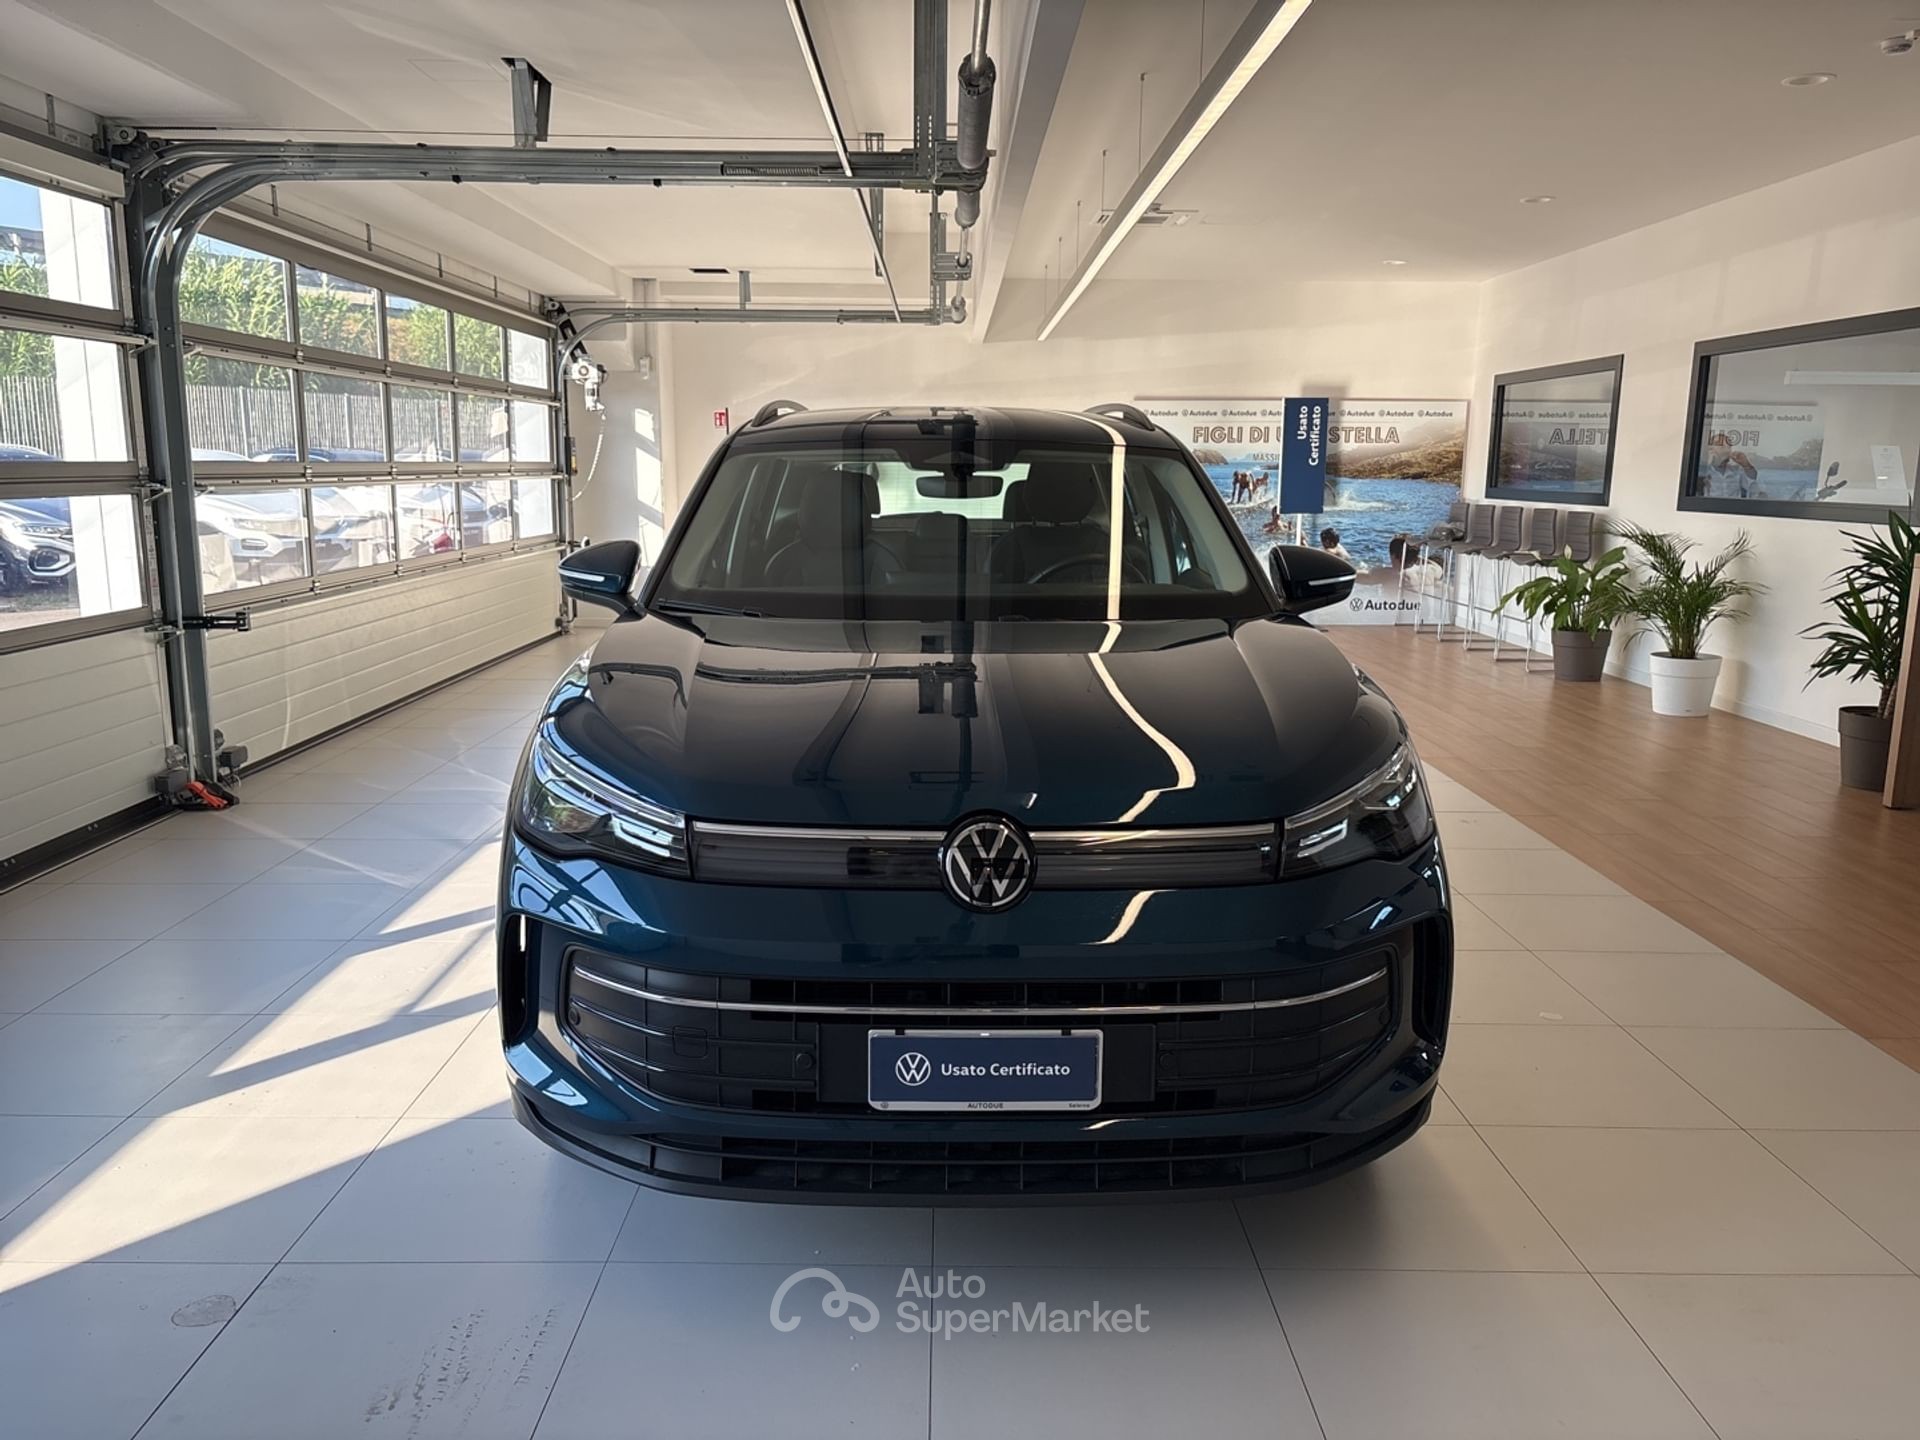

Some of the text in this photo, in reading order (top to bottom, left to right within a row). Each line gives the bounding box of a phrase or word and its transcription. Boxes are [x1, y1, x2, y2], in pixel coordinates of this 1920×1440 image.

[1192, 426, 1243, 444] FIGLI
[1249, 426, 1270, 444] DI
[1328, 426, 1400, 444] STELLA
[1297, 405, 1309, 440] Usato
[1308, 405, 1322, 466] Certificato
[941, 1063, 986, 1076] Usato
[989, 1062, 1071, 1076] Certificato
